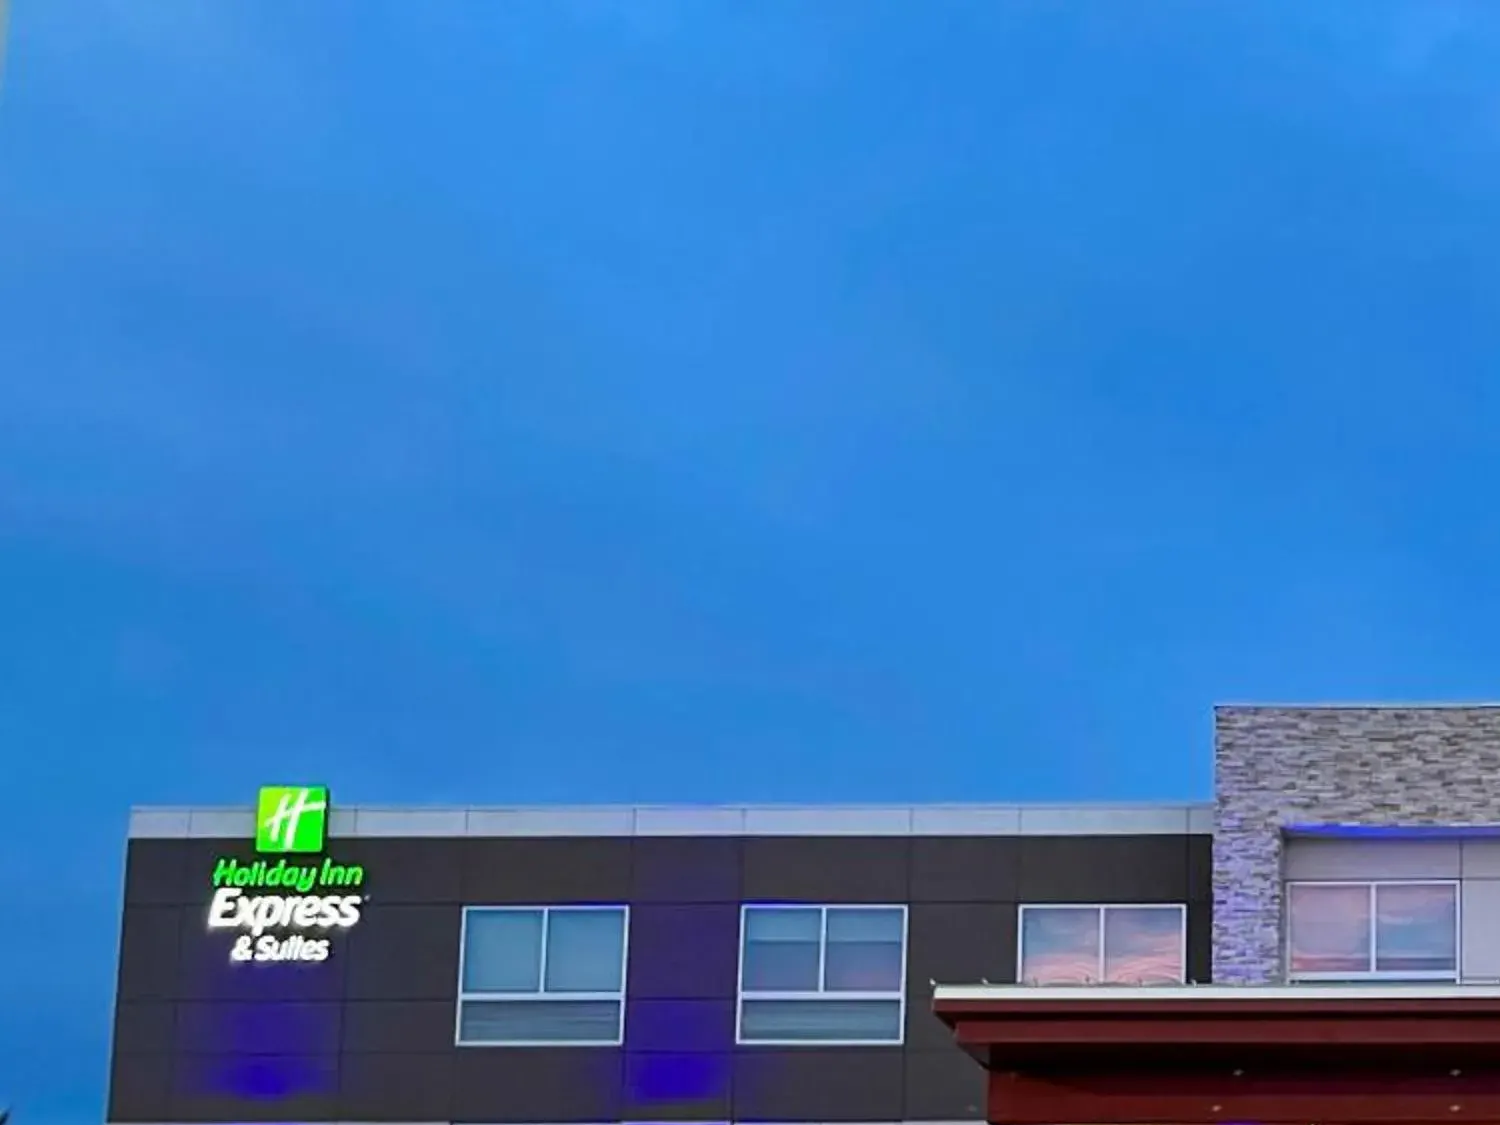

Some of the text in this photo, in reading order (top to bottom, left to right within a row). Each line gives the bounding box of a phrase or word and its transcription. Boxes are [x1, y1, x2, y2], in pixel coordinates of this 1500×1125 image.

[213, 858, 363, 892] Holiday Inn
[208, 887, 362, 936] Express
[230, 934, 330, 961] & Suites
